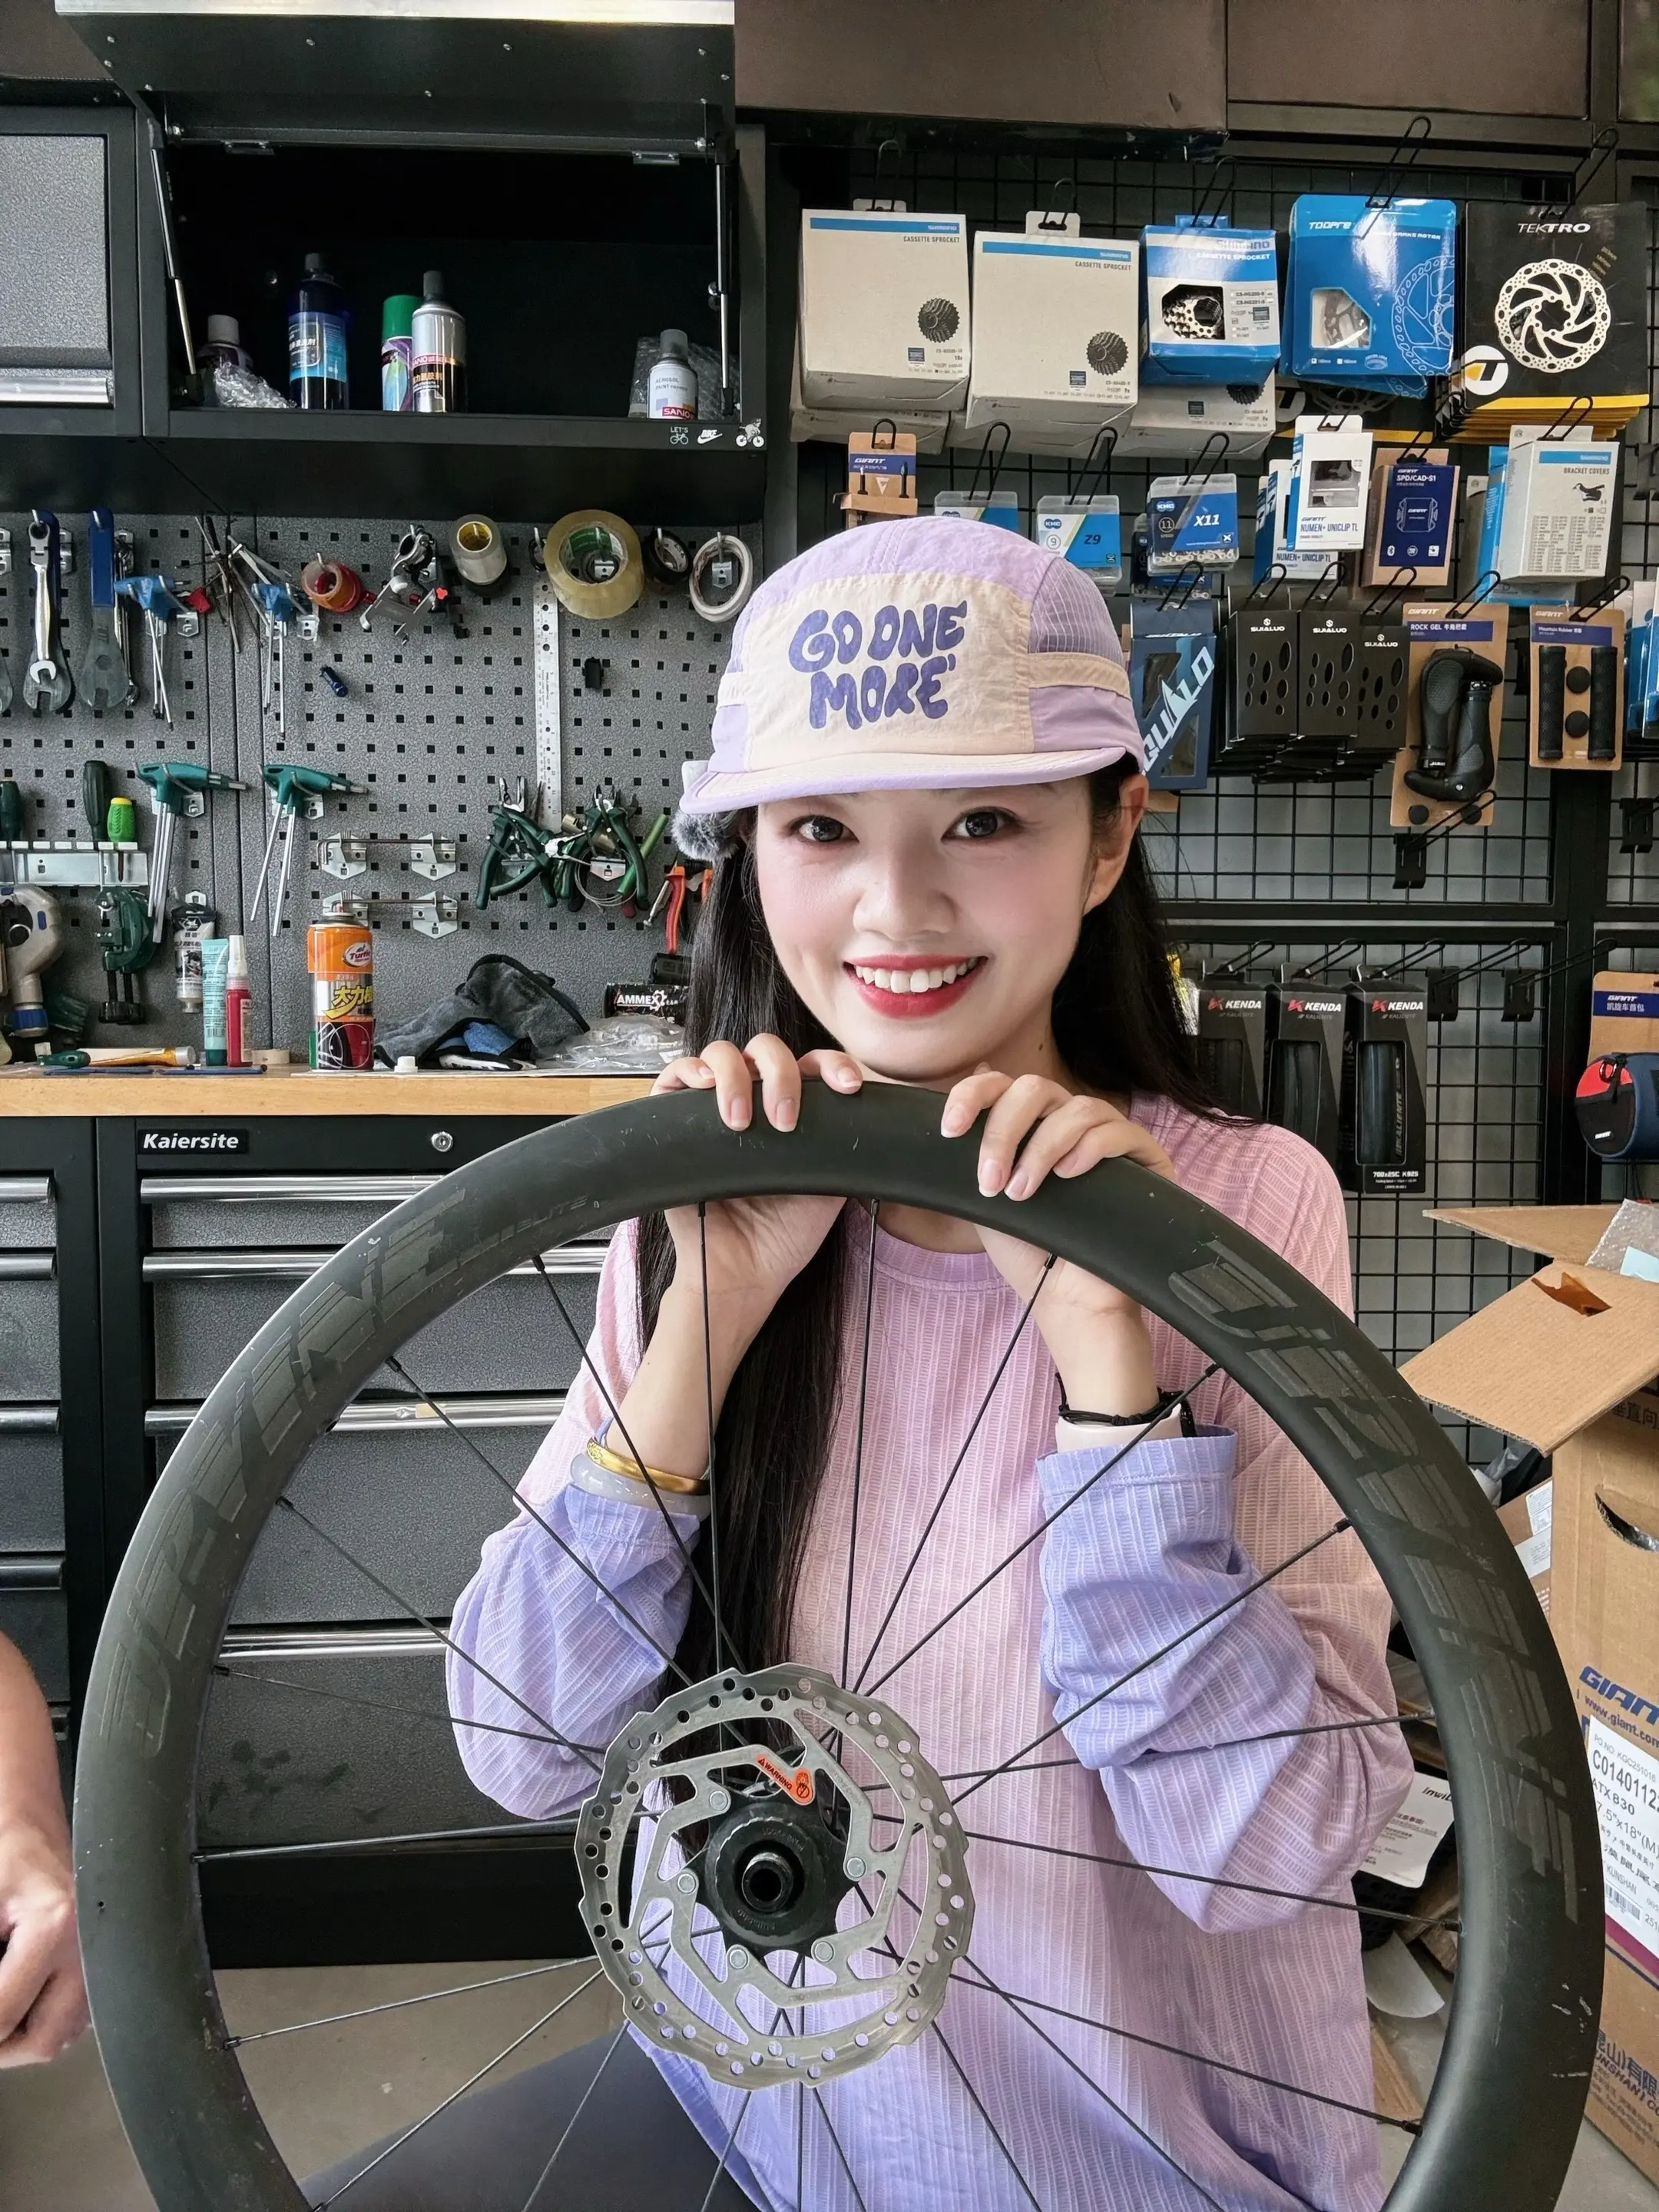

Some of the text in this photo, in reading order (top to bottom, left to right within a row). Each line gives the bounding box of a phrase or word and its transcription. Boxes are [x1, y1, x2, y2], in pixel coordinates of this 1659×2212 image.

[1518, 223, 1591, 233] TEKTRO
[664, 408, 690, 419] SANO
[1194, 514, 1220, 527] X11
[1327, 523, 1351, 531] UNICLIP
[1352, 523, 1359, 531] TL
[1084, 535, 1101, 545] Z9
[1302, 553, 1324, 562] UNICLIP
[788, 599, 968, 674] GO ONE
[1225, 1000, 1262, 1010] KENDA
[1305, 1002, 1342, 1012] KENDA
[1387, 1001, 1424, 1011] KENDA
[143, 1133, 239, 1150] Kaiersite
[1612, 1401, 1659, 1430] 垂直向
[1579, 1665, 1659, 1726] GIAN
[764, 1761, 793, 1790] WARNING
[1592, 1750, 1659, 1813] C0140112
[1612, 1792, 1635, 1816] 830
[1606, 1864, 1637, 1895] KUNSHAN
